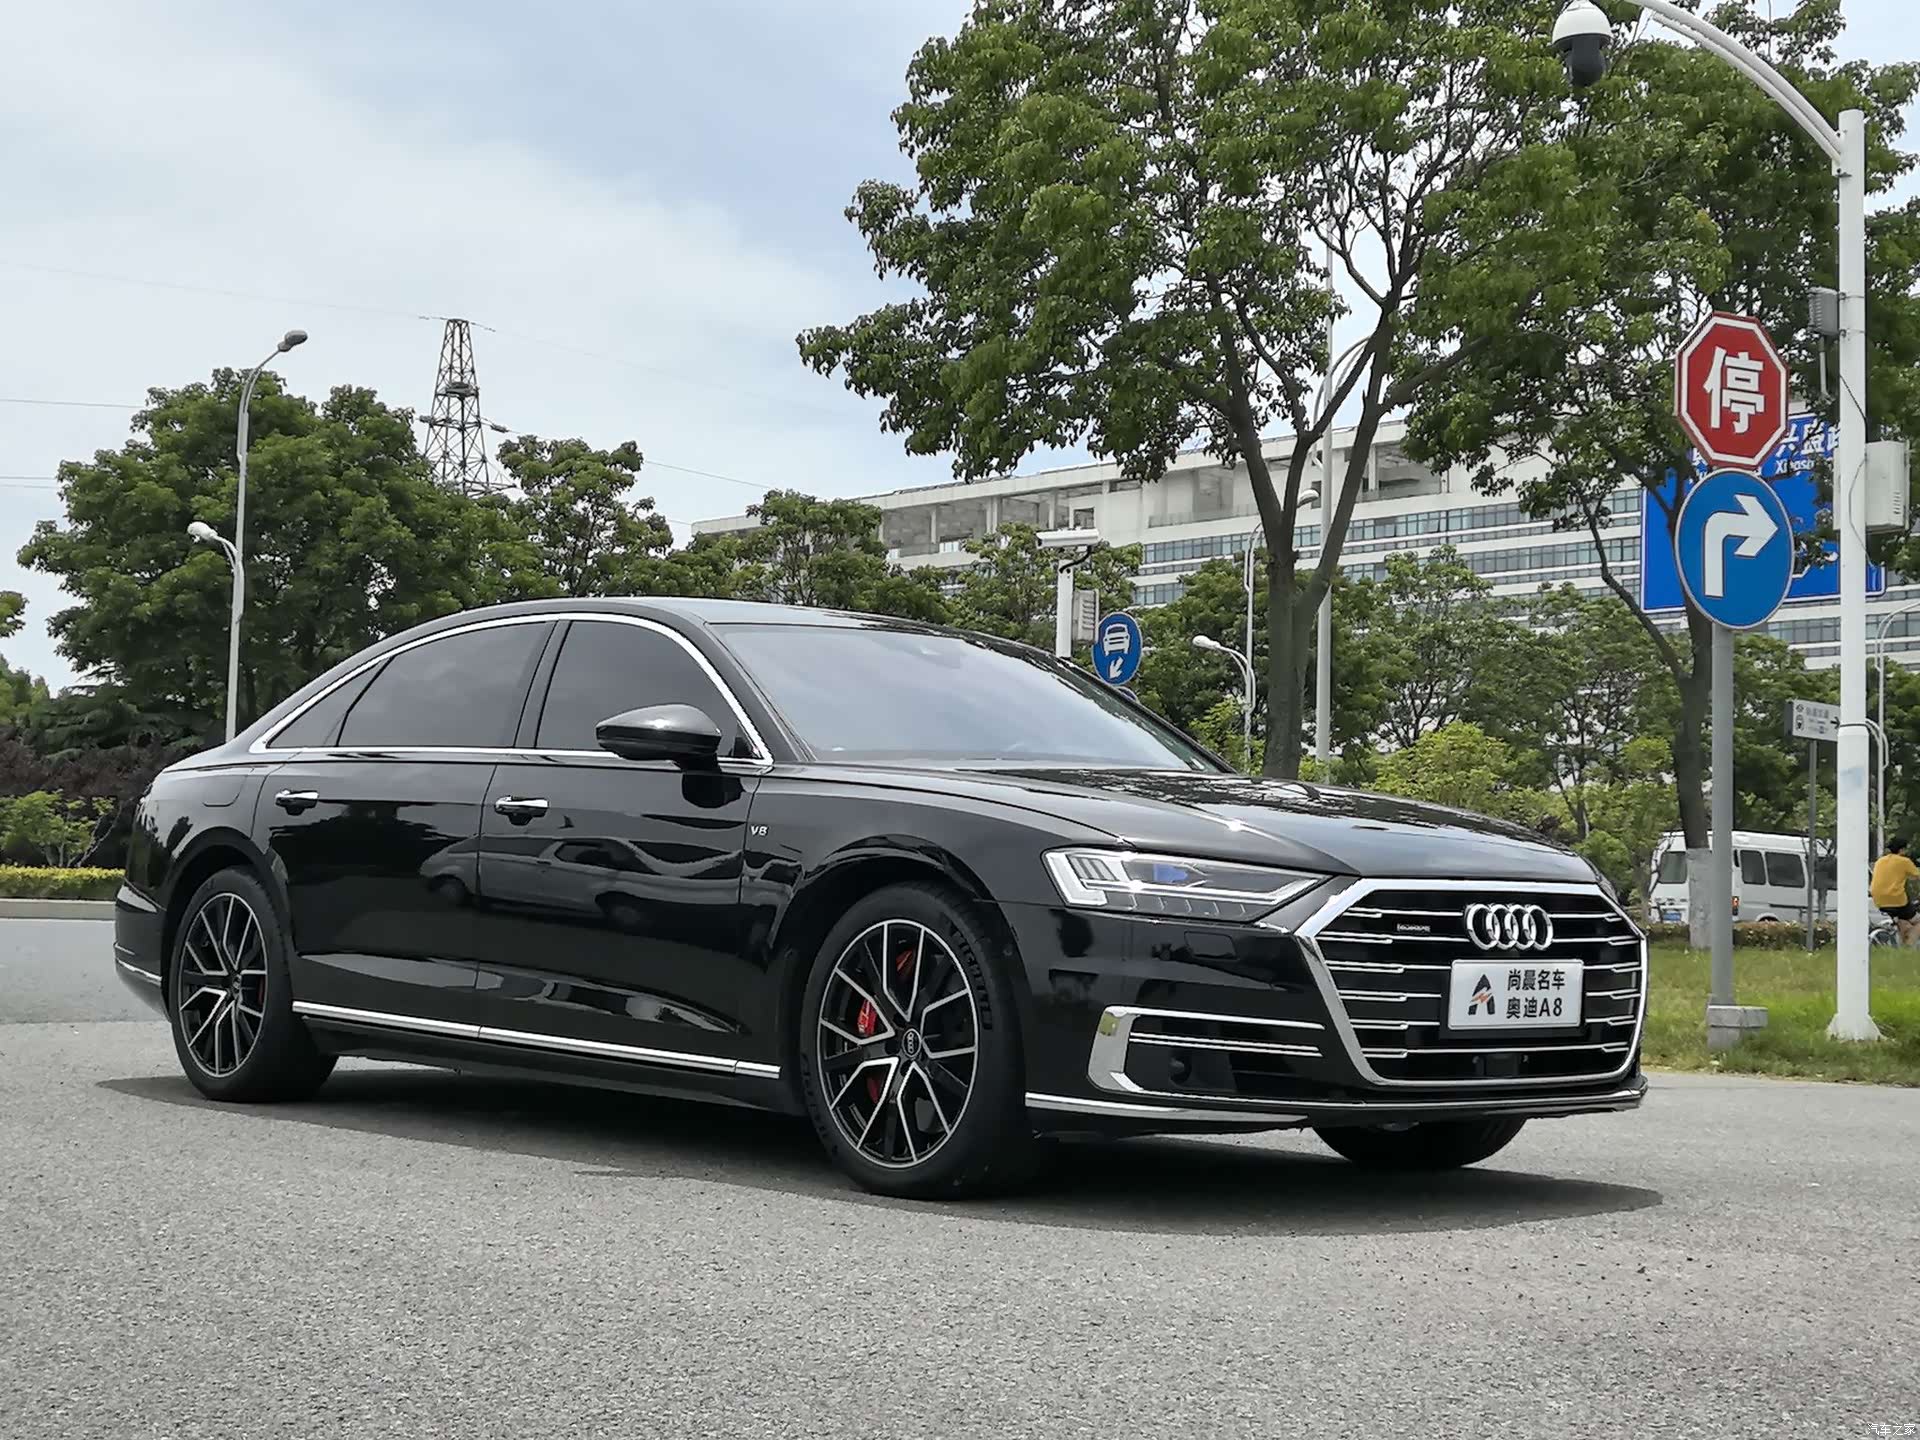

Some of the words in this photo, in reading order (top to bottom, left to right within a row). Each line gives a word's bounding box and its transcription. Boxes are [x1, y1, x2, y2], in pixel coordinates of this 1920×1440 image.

[1703, 345, 1765, 434] 停
[1507, 968, 1566, 991] 尚晨名车
[1506, 997, 1562, 1019] 奥迪A8
